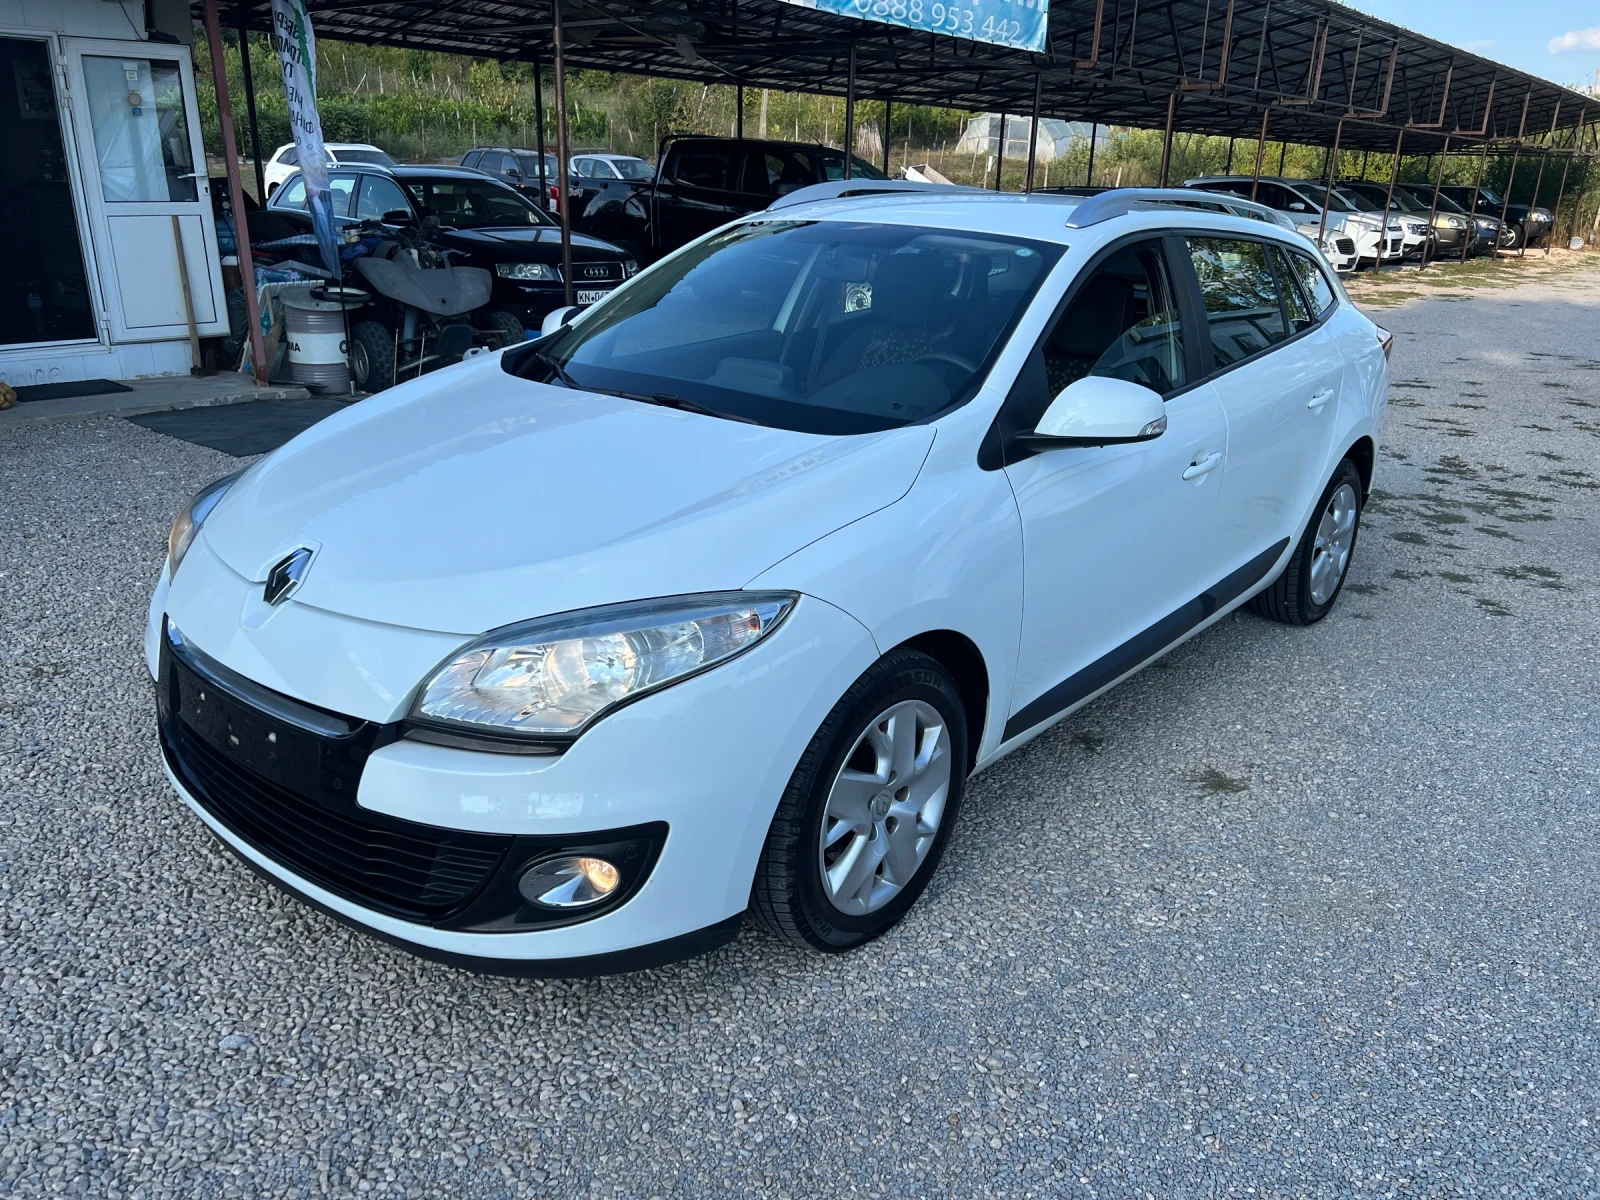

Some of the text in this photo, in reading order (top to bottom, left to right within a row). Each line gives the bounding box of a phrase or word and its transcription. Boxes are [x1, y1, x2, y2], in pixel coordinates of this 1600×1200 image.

[856, 0, 923, 23] 0888
[931, 2, 974, 34] 953
[981, 15, 1024, 44] 442
